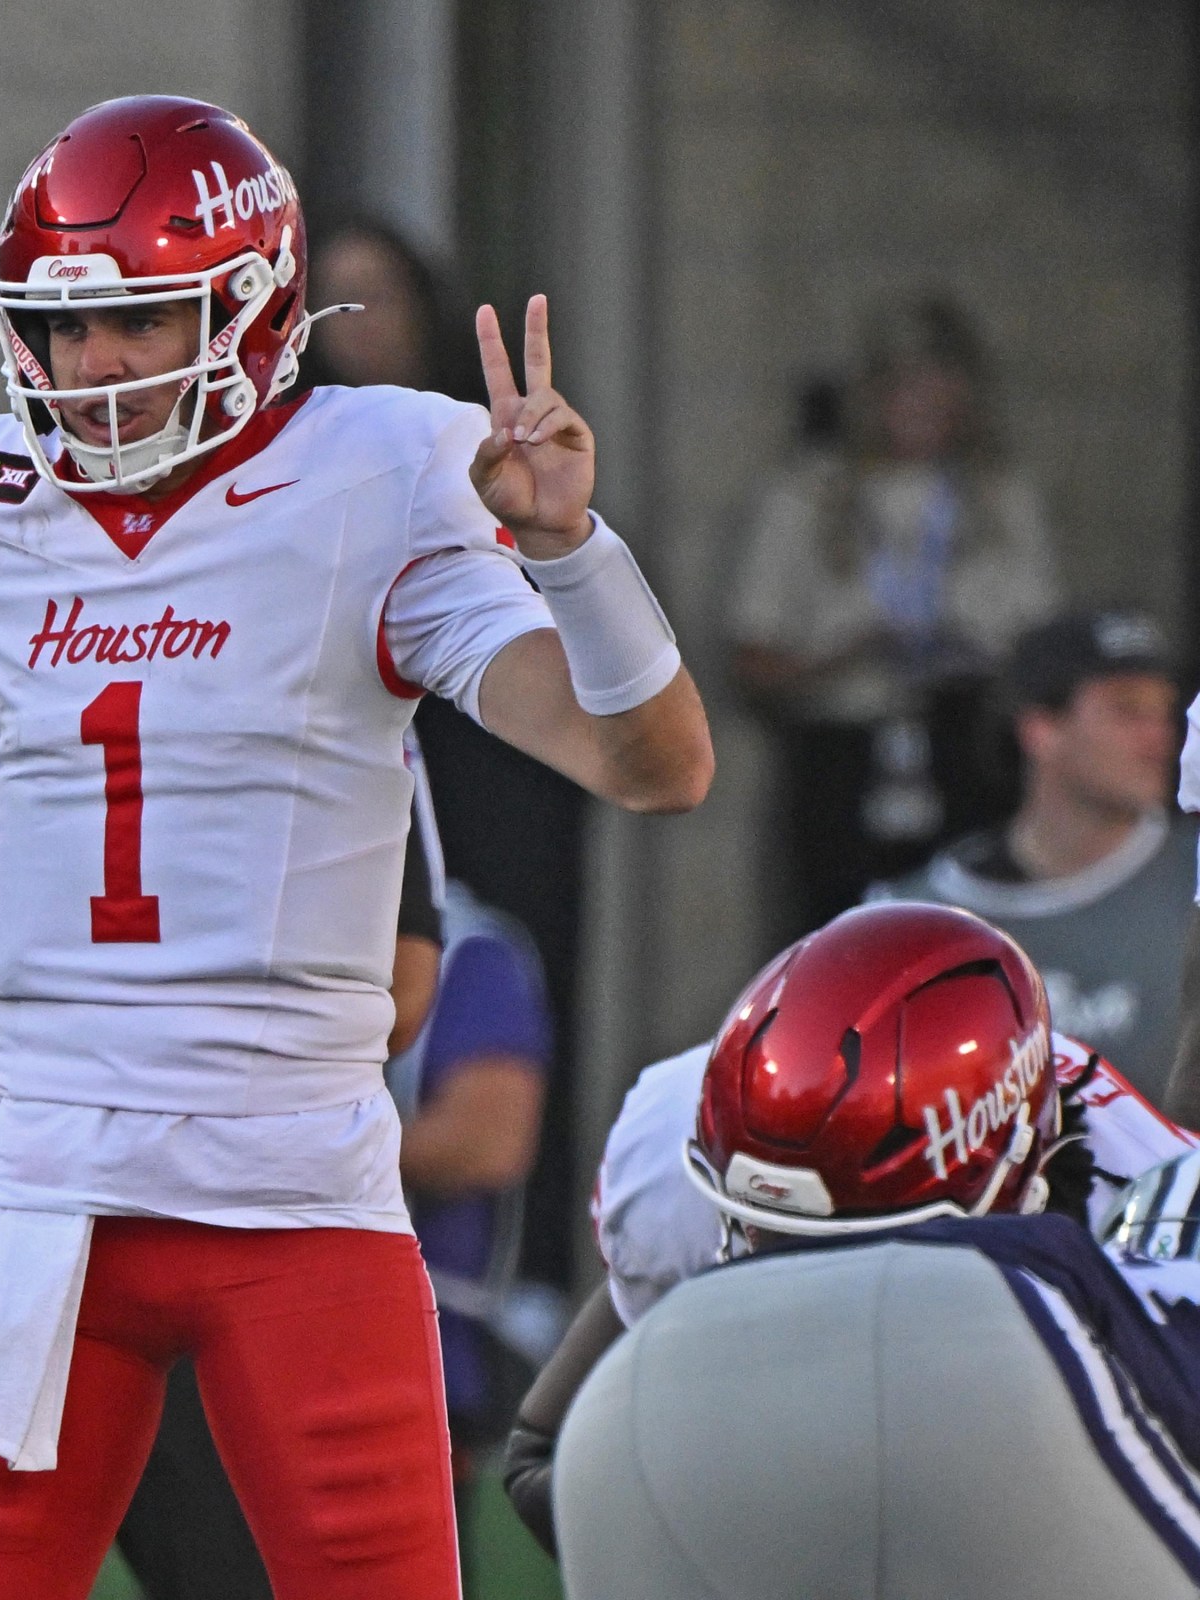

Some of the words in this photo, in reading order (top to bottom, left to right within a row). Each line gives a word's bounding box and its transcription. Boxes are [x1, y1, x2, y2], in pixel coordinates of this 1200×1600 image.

[47, 259, 89, 282] Coogs
[28, 595, 232, 670] Houston
[80, 680, 161, 943] 1
